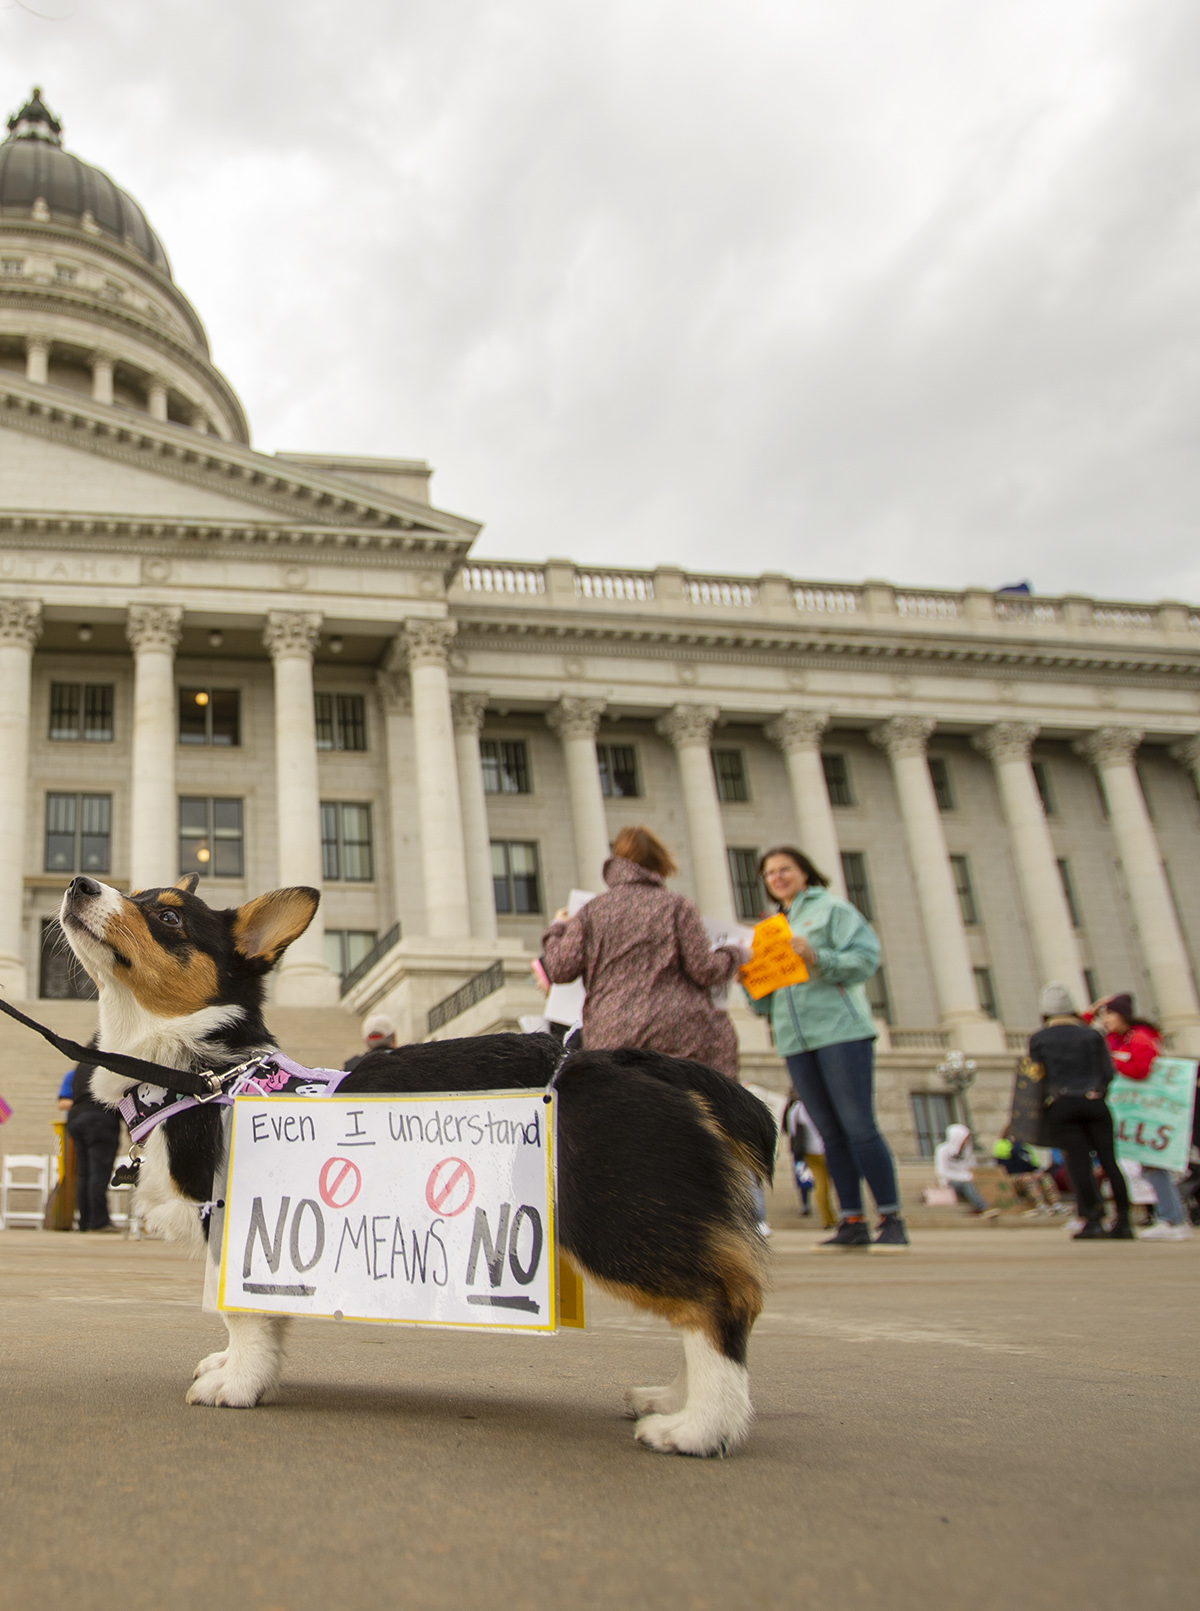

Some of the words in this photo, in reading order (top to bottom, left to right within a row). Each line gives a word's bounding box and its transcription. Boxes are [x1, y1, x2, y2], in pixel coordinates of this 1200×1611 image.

[251, 1112, 316, 1143] Even
[345, 1110, 367, 1137] I
[388, 1109, 542, 1148] understand
[1118, 1118, 1175, 1151] LLS
[242, 1195, 326, 1279] NO
[334, 1214, 449, 1287] MEANS
[465, 1202, 544, 1288] NO
